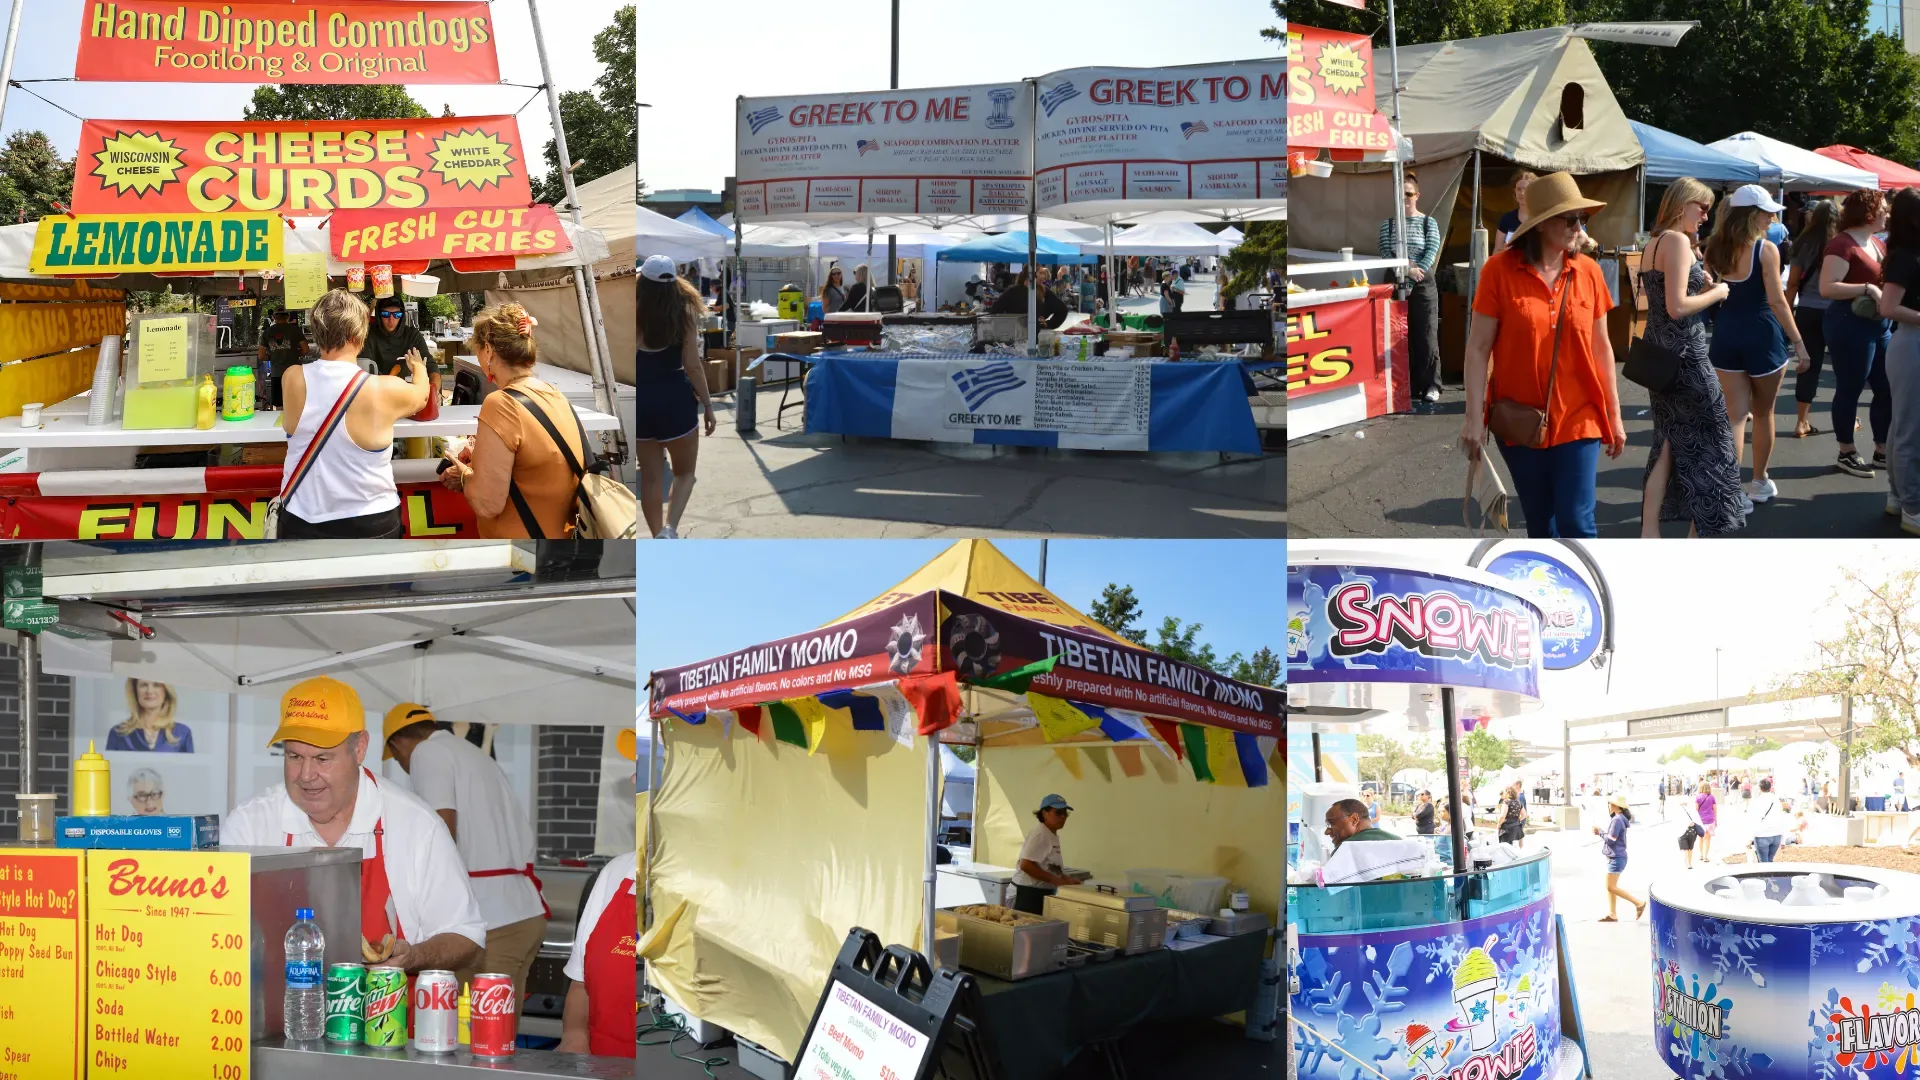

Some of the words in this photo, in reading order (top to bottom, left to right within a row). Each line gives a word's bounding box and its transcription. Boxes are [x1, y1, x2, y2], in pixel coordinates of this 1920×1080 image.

[91, 2, 186, 41] Hand
[197, 5, 317, 53] Dipped
[328, 11, 490, 52] Corndogs
[154, 45, 285, 78] Footlong
[291, 51, 312, 73] &
[319, 50, 428, 79] Original
[1325, 68, 1360, 79] CHEDDAR
[1330, 58, 1354, 67] WHITE
[1089, 78, 1199, 107] GREEK
[1202, 75, 1251, 103] TO
[788, 101, 879, 128] GREEK
[881, 99, 919, 124] TO
[925, 96, 971, 123] ME
[1066, 113, 1130, 125] GYROS/PITA
[1213, 119, 1258, 128] SEAFOOD
[1333, 111, 1374, 129] CUT
[1098, 124, 1133, 132] SERVED
[1134, 123, 1148, 131] ON
[1150, 124, 1169, 133] PITA
[1329, 128, 1389, 147] FRIES
[110, 151, 170, 164] WISCONSIN
[204, 130, 410, 164] CHEESE
[450, 146, 490, 157] WHITE
[117, 166, 160, 175] CHEESE
[443, 158, 501, 169] CHEDDAR
[186, 165, 429, 213] CURDS
[1207, 173, 1239, 181] SHRIMP
[45, 219, 269, 266] LEMONADE
[341, 211, 437, 258] FRESH
[453, 208, 528, 230] CUT
[442, 229, 556, 254] FRIES
[146, 324, 182, 333] Lemonade
[949, 413, 985, 425] GREEK
[987, 414, 1001, 425] TO
[1002, 415, 1022, 426] ME
[1000, 602, 1064, 615] FAMILY
[1337, 583, 1532, 664] SNOWIE
[680, 658, 729, 692] TIBETAN
[733, 643, 788, 680] FAMILY
[790, 628, 858, 668] MOMO
[1039, 631, 1142, 681] TIBETAN
[1146, 657, 1210, 697] FAMILY
[1213, 679, 1263, 712] MOMO
[708, 690, 720, 701] with
[720, 689, 729, 699] No
[730, 683, 754, 698] artificial
[780, 677, 790, 689] No
[791, 673, 814, 688] colors
[815, 670, 832, 685] and
[834, 668, 846, 681] No
[848, 663, 873, 679] MSG
[1033, 672, 1063, 691] eshly
[1066, 677, 1112, 697] prepared
[1114, 684, 1133, 699] with
[1135, 688, 1148, 701] No
[1149, 691, 1180, 708] artificial
[1207, 705, 1218, 717] No
[1218, 710, 1236, 723] colors
[1236, 714, 1248, 725] and
[1249, 716, 1258, 727] No
[1639, 715, 1681, 729] CENTENNIAL
[1683, 712, 1709, 724] LAKES
[90, 828, 133, 836] DISPOSABLE
[133, 828, 162, 836] GLOVES
[14, 864, 23, 881] is
[27, 868, 33, 881] a
[107, 858, 229, 899] Bruno's
[0, 889, 20, 912] tyle
[25, 888, 44, 908] Hot
[48, 889, 76, 914] Dog?
[146, 904, 166, 917] Since
[170, 906, 190, 918] 1947
[0, 921, 15, 936] Hot
[19, 922, 36, 941] Dog
[95, 923, 115, 941] Hot
[121, 924, 143, 948] Dog
[211, 933, 243, 950] 5.00
[0, 941, 25, 961] Poppy
[29, 943, 51, 959] Seed
[55, 944, 73, 960] Bun
[0, 965, 24, 979] stard
[95, 960, 141, 983] Chicago
[146, 963, 177, 985] Style
[209, 969, 242, 987] 6.00
[289, 967, 320, 976] AQUAFINA
[95, 997, 124, 1016] Soda
[211, 1008, 243, 1025] 2.00
[835, 988, 862, 1014] TIBETAN
[861, 1004, 890, 1030] FAMILY
[888, 1022, 917, 1048] MOMO
[1666, 985, 1722, 1039] STATION
[95, 1023, 139, 1044] Bottled
[145, 1027, 180, 1047] Water
[211, 1035, 243, 1052] 2.00
[827, 1024, 845, 1043] Beef
[843, 1035, 865, 1060] Momo
[4, 1046, 31, 1066] Spear
[95, 1050, 127, 1072] Chips
[212, 1064, 241, 1080] 1.00
[818, 1046, 830, 1064] Tofu
[830, 1058, 842, 1077] veg
